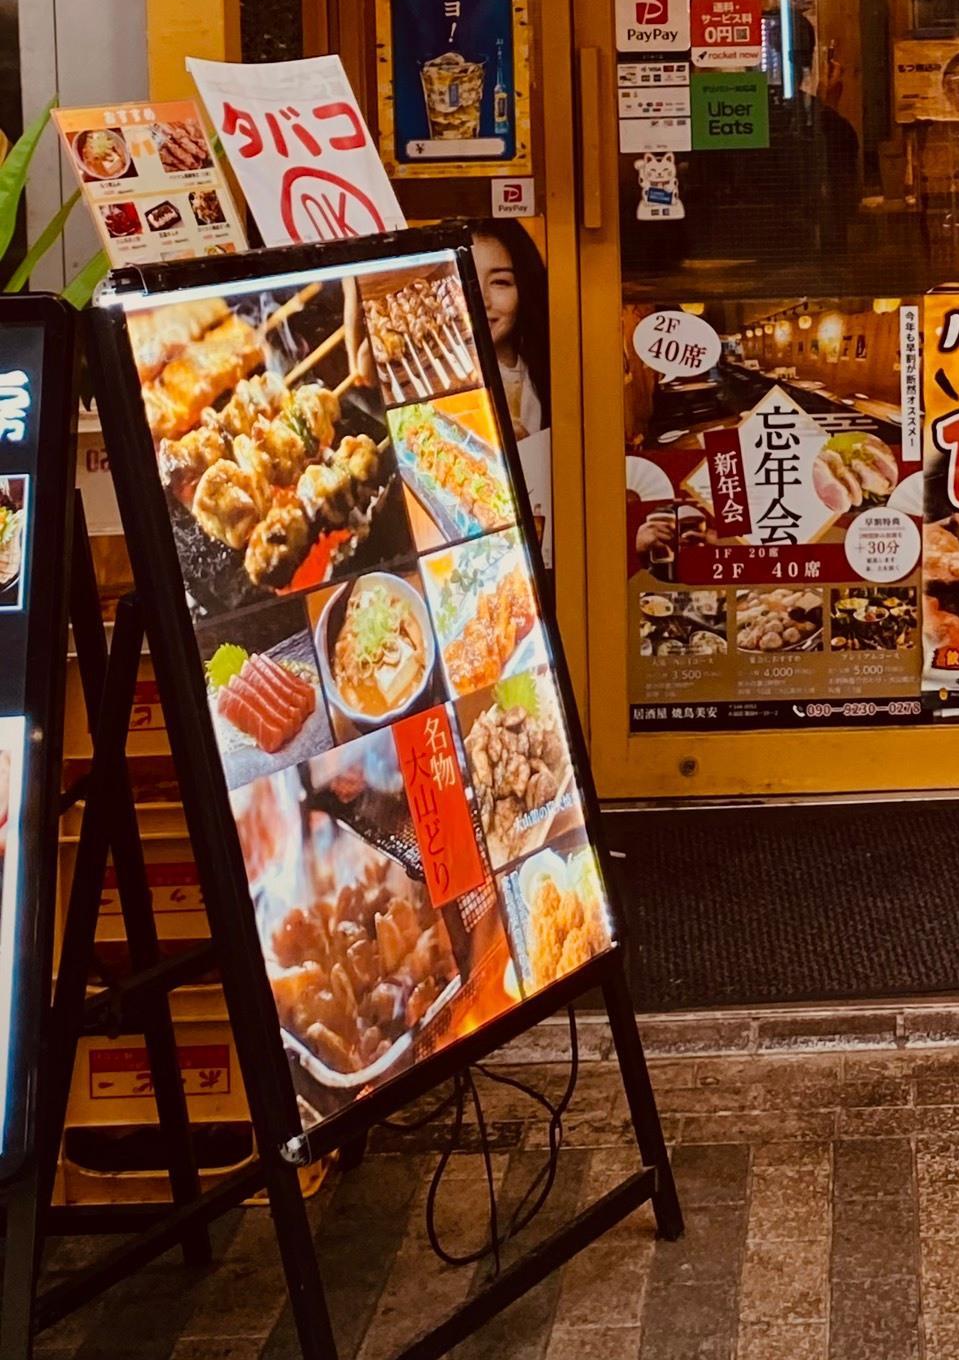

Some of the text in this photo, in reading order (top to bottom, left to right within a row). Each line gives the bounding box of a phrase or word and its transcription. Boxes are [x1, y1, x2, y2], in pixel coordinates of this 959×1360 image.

[627, 29, 679, 42] PayPay
[708, 102, 752, 117] Uber
[221, 101, 367, 159] タバコ
[708, 120, 753, 136] Eats
[498, 204, 528, 213] PayPay
[653, 315, 680, 335] 2F
[648, 338, 707, 369] 40席
[713, 451, 744, 523] 新年会
[755, 406, 802, 545] 忘年会
[713, 561, 820, 579] 2F 40席
[424, 717, 456, 790] 名物
[406, 747, 449, 894] 大山どり
